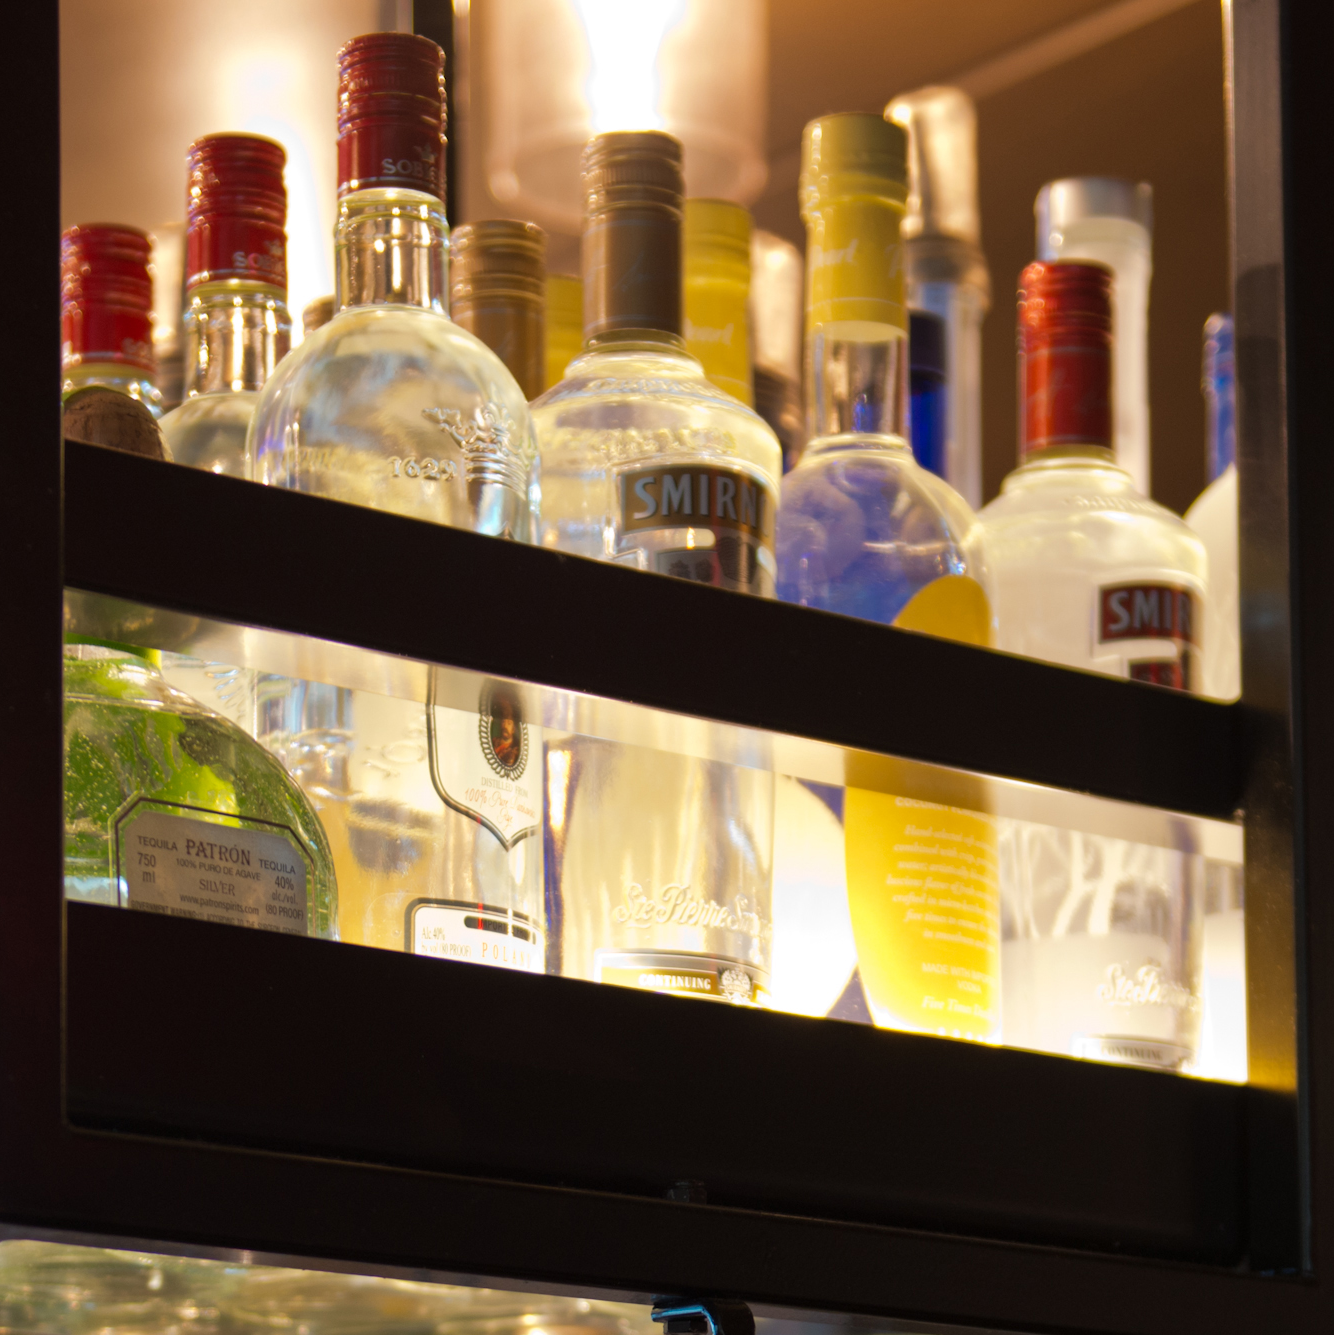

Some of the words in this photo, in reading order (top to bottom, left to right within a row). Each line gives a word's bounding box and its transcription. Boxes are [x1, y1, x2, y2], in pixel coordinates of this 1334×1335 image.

[387, 455, 458, 482] 1629
[464, 787, 488, 808] 100%
[137, 835, 178, 851] TEQUILA
[185, 838, 251, 866] PATRÓN
[258, 858, 296, 875] TEQUILA
[137, 852, 156, 868] 750
[175, 857, 197, 869] 100%
[198, 861, 222, 874] PURO
[223, 866, 234, 876] DE
[235, 869, 261, 881] AGAVE
[199, 878, 236, 897] SILVER
[274, 875, 294, 891] 40%
[179, 892, 260, 917] www.patronspirits.com
[265, 903, 278, 916] (80
[278, 905, 304, 922] PROOF)
[921, 962, 949, 975] MADE
[950, 966, 971, 977] WITH
[638, 973, 712, 991] CONTINUING
